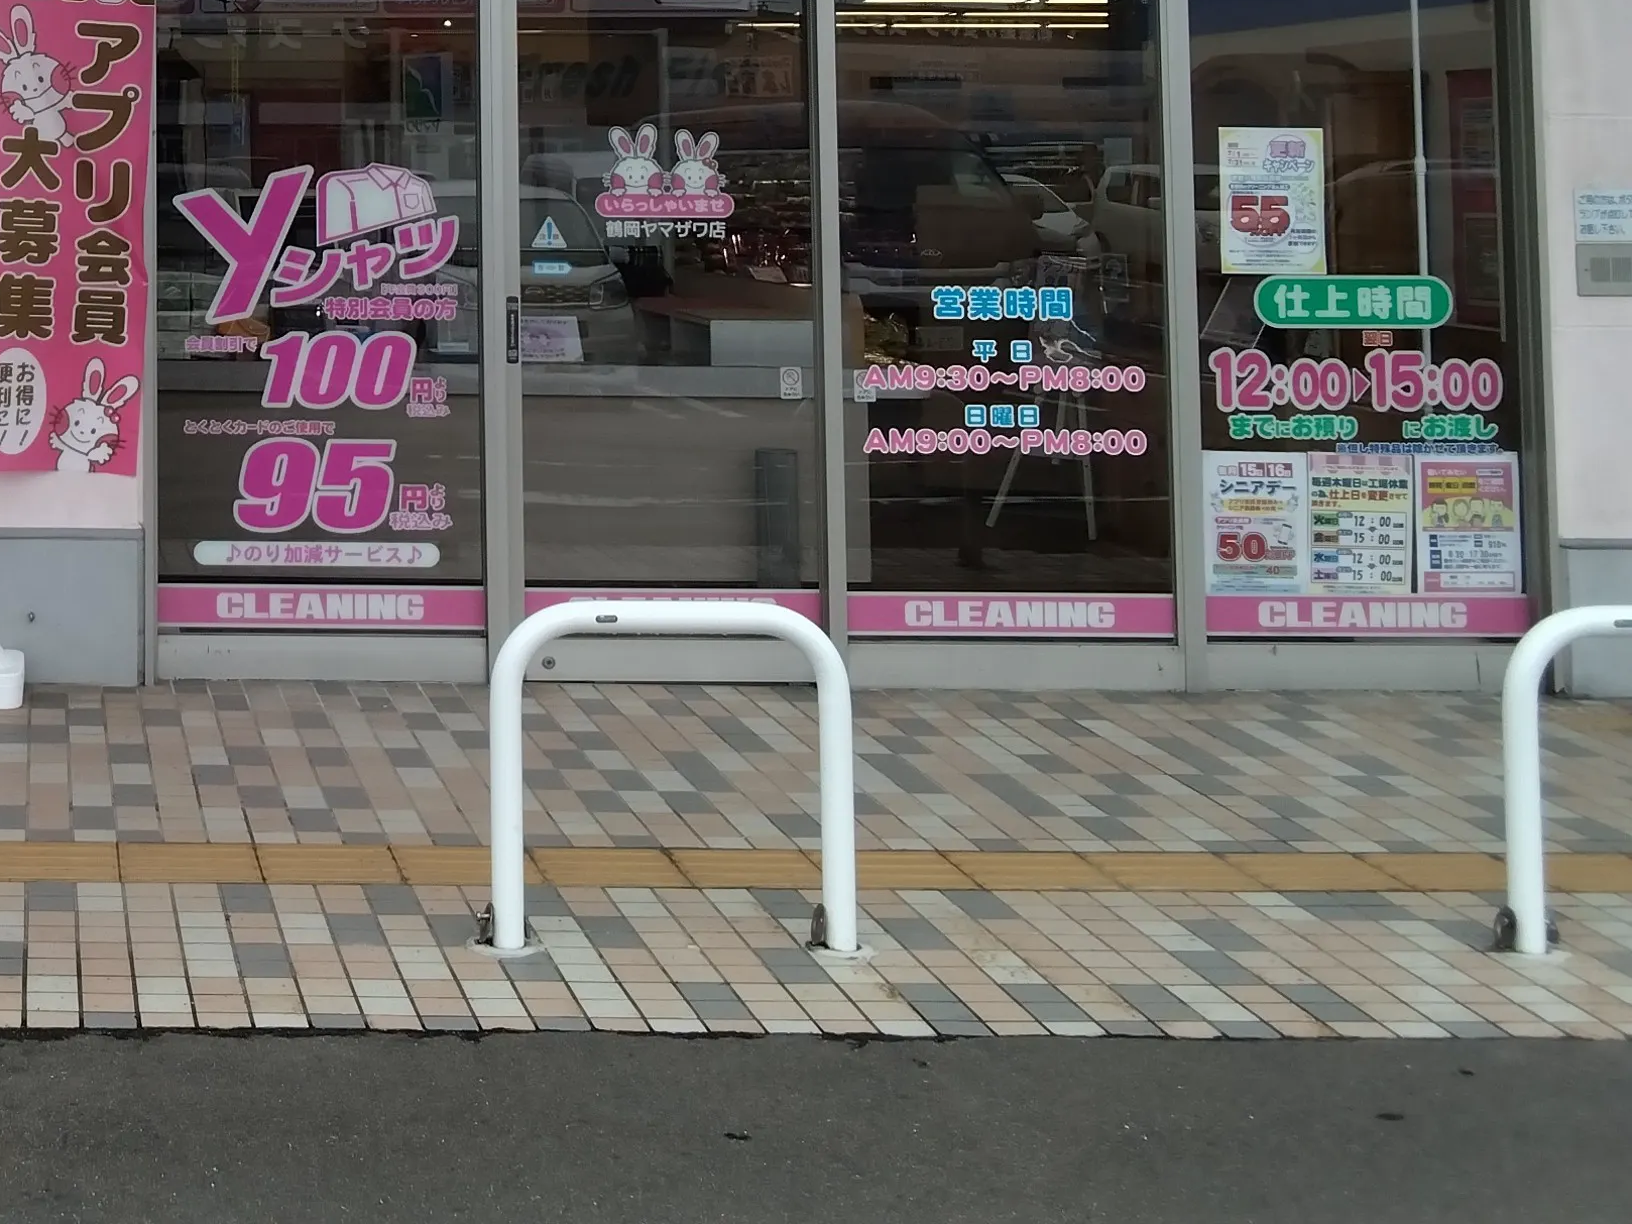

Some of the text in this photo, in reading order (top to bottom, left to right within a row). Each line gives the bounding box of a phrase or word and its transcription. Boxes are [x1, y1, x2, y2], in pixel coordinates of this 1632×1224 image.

[1263, 158, 1315, 174] キャンペーン
[69, 21, 142, 345] アプリ会員
[604, 198, 725, 214] いらっしゃいませ
[605, 220, 727, 240] 鶴岡ヤマザワ店
[325, 297, 458, 320] 特別会員の方
[931, 286, 1074, 321] 営業時間
[1273, 284, 1433, 320] 仕上時間
[261, 331, 417, 410] 100
[1209, 347, 1504, 412] 12:00 15:00
[183, 420, 336, 436] とくとくカードのご使用で
[964, 404, 1040, 427] 日曜日
[1228, 414, 1499, 441] までにお預り にお渡し
[233, 437, 397, 534] 95
[1219, 479, 1297, 495] シニアデー
[389, 512, 454, 531] 税込み
[1217, 531, 1268, 563] 50
[216, 592, 425, 621] CLEANING
[904, 600, 1116, 629] CLEANING
[1258, 601, 1468, 629] CLEANING
